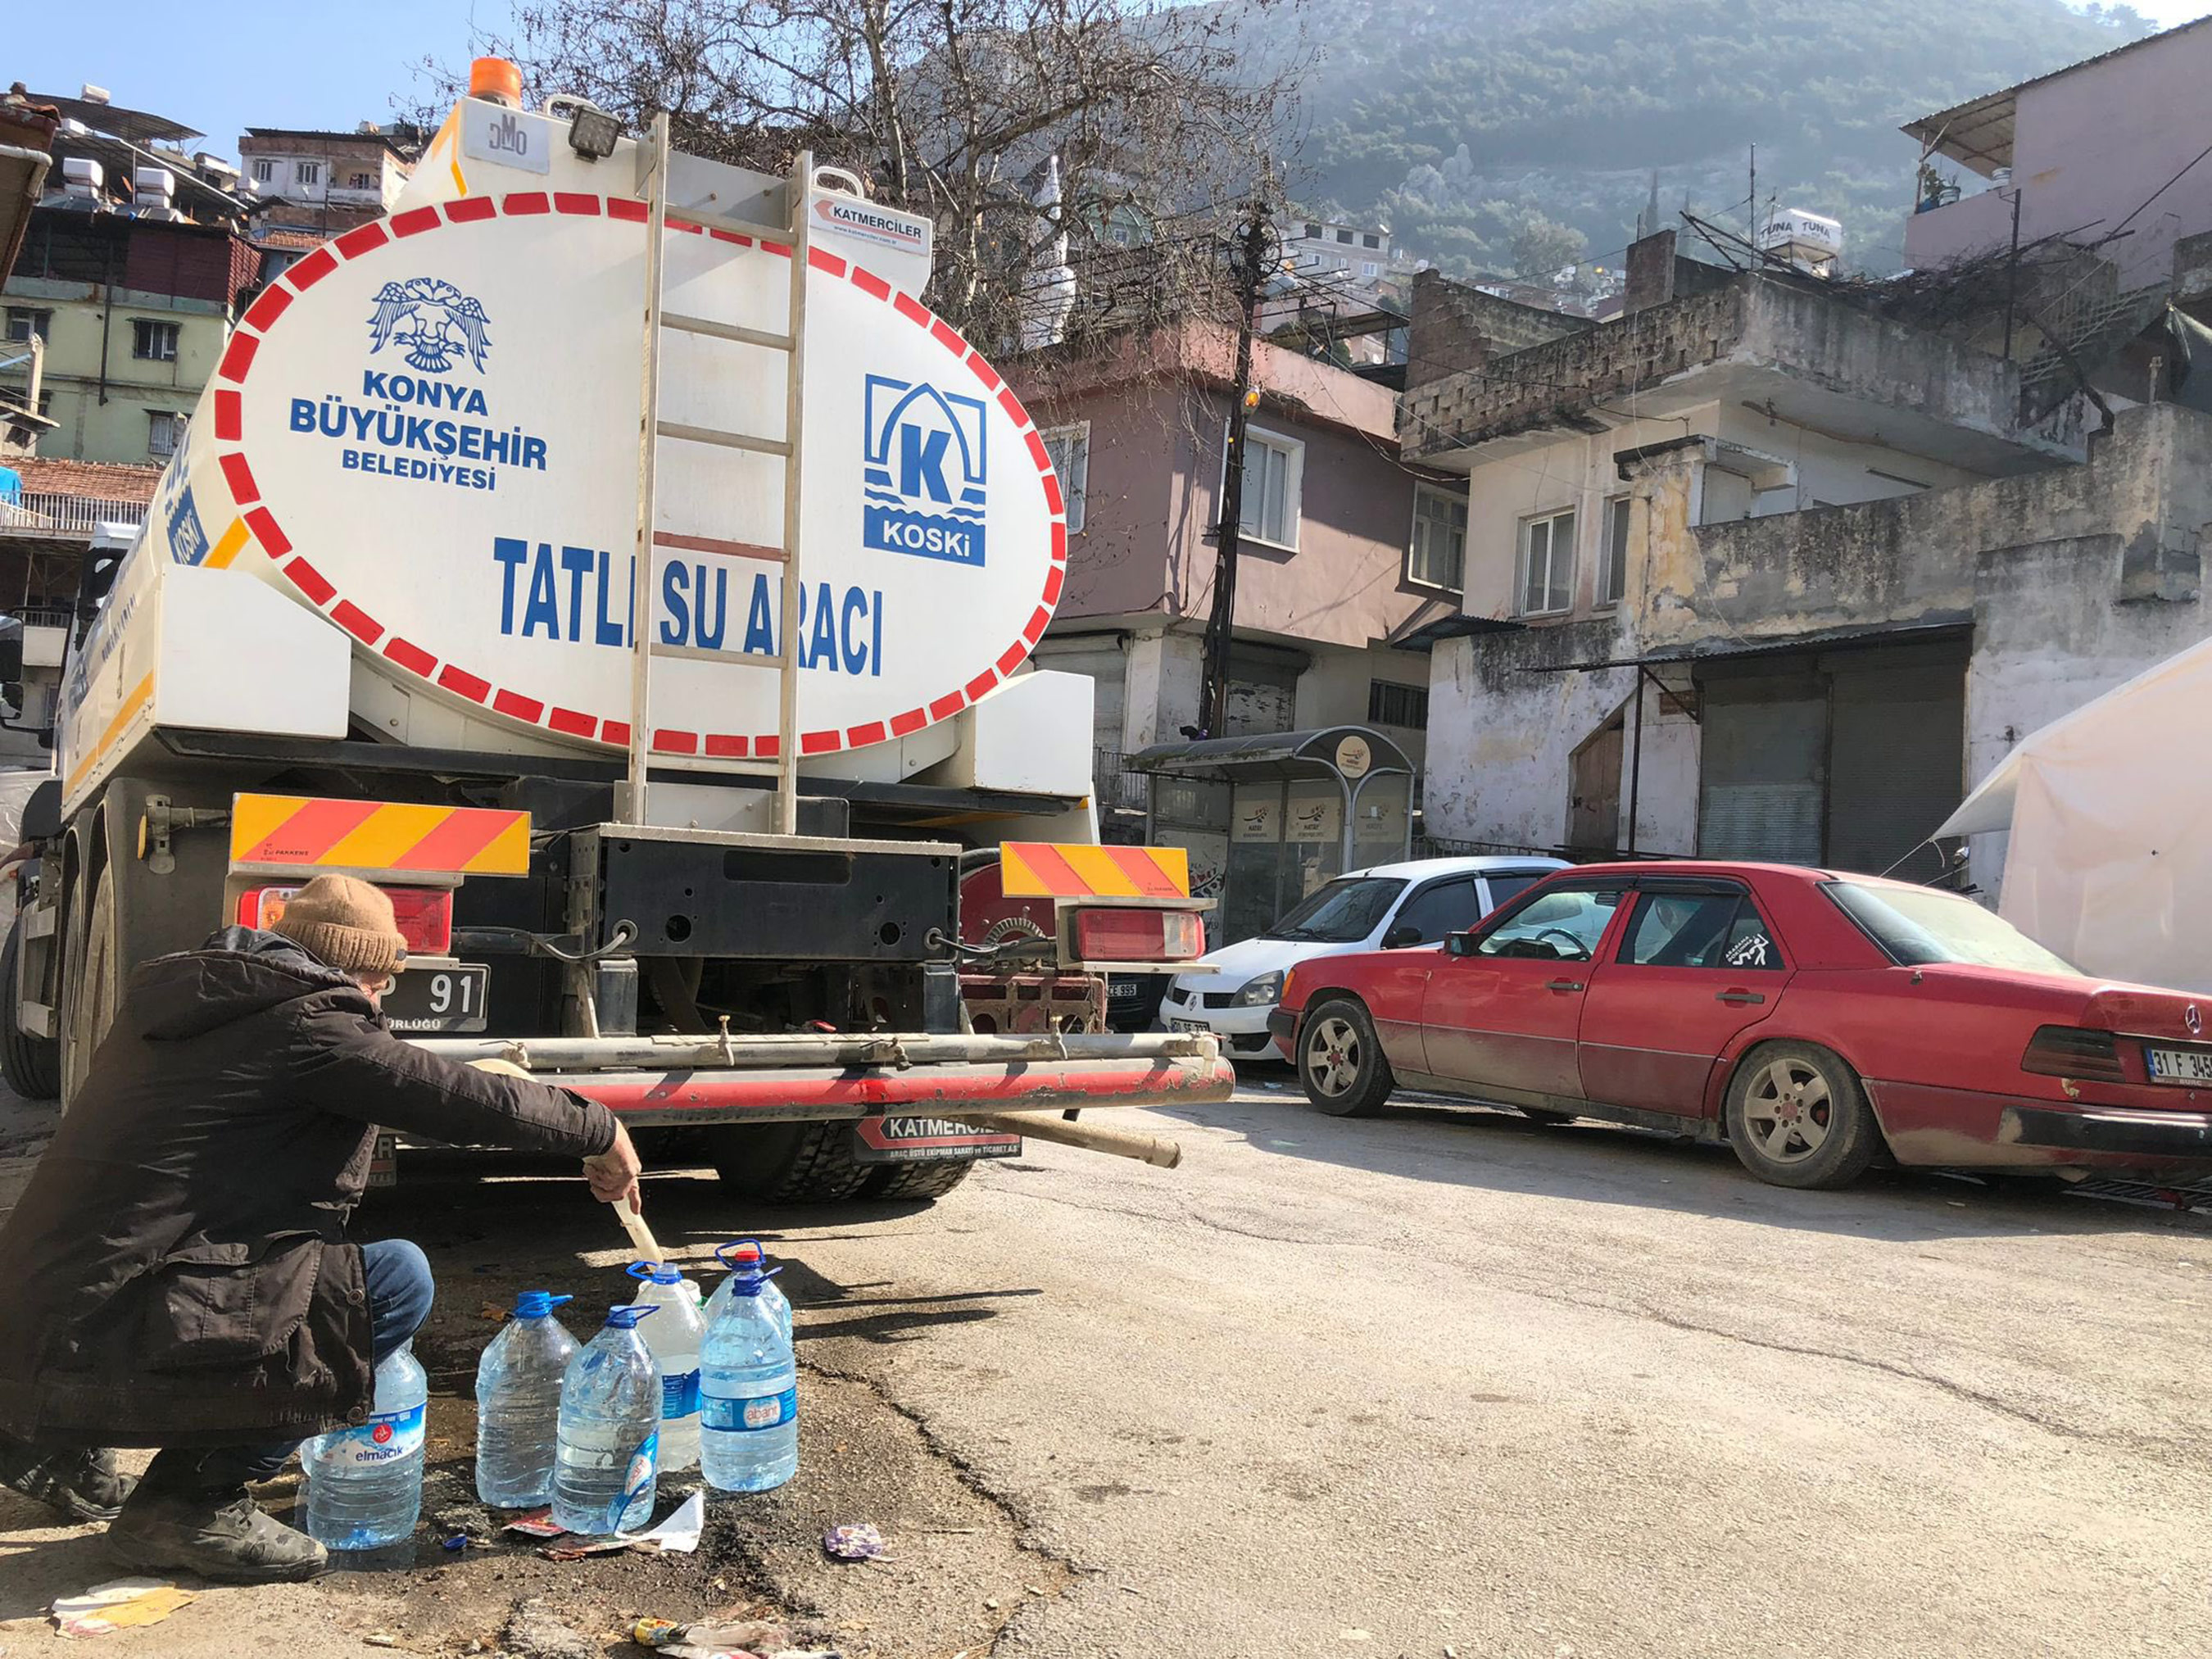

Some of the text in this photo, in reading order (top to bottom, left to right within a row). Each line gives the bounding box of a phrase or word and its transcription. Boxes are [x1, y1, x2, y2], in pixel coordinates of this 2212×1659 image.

[834, 206, 921, 238] KATMERCİLER
[1759, 222, 1793, 238] TUNA
[1802, 222, 1830, 238] TUNA
[363, 369, 488, 416] KONYA
[290, 394, 546, 471] BÜYÜKŞEHİR
[342, 449, 496, 491] BELEDİYESİ
[660, 560, 727, 650] SU
[429, 974, 472, 1013] 91
[1120, 985, 1135, 995] 995
[2154, 1052, 2212, 1077] 31 F 345
[890, 1118, 1002, 1137] KATMER
[890, 1149, 908, 1159] ARAÇ
[927, 1147, 953, 1157] EKİPMAN
[983, 1145, 1007, 1154] TİCARET
[746, 1405, 777, 1421] abant
